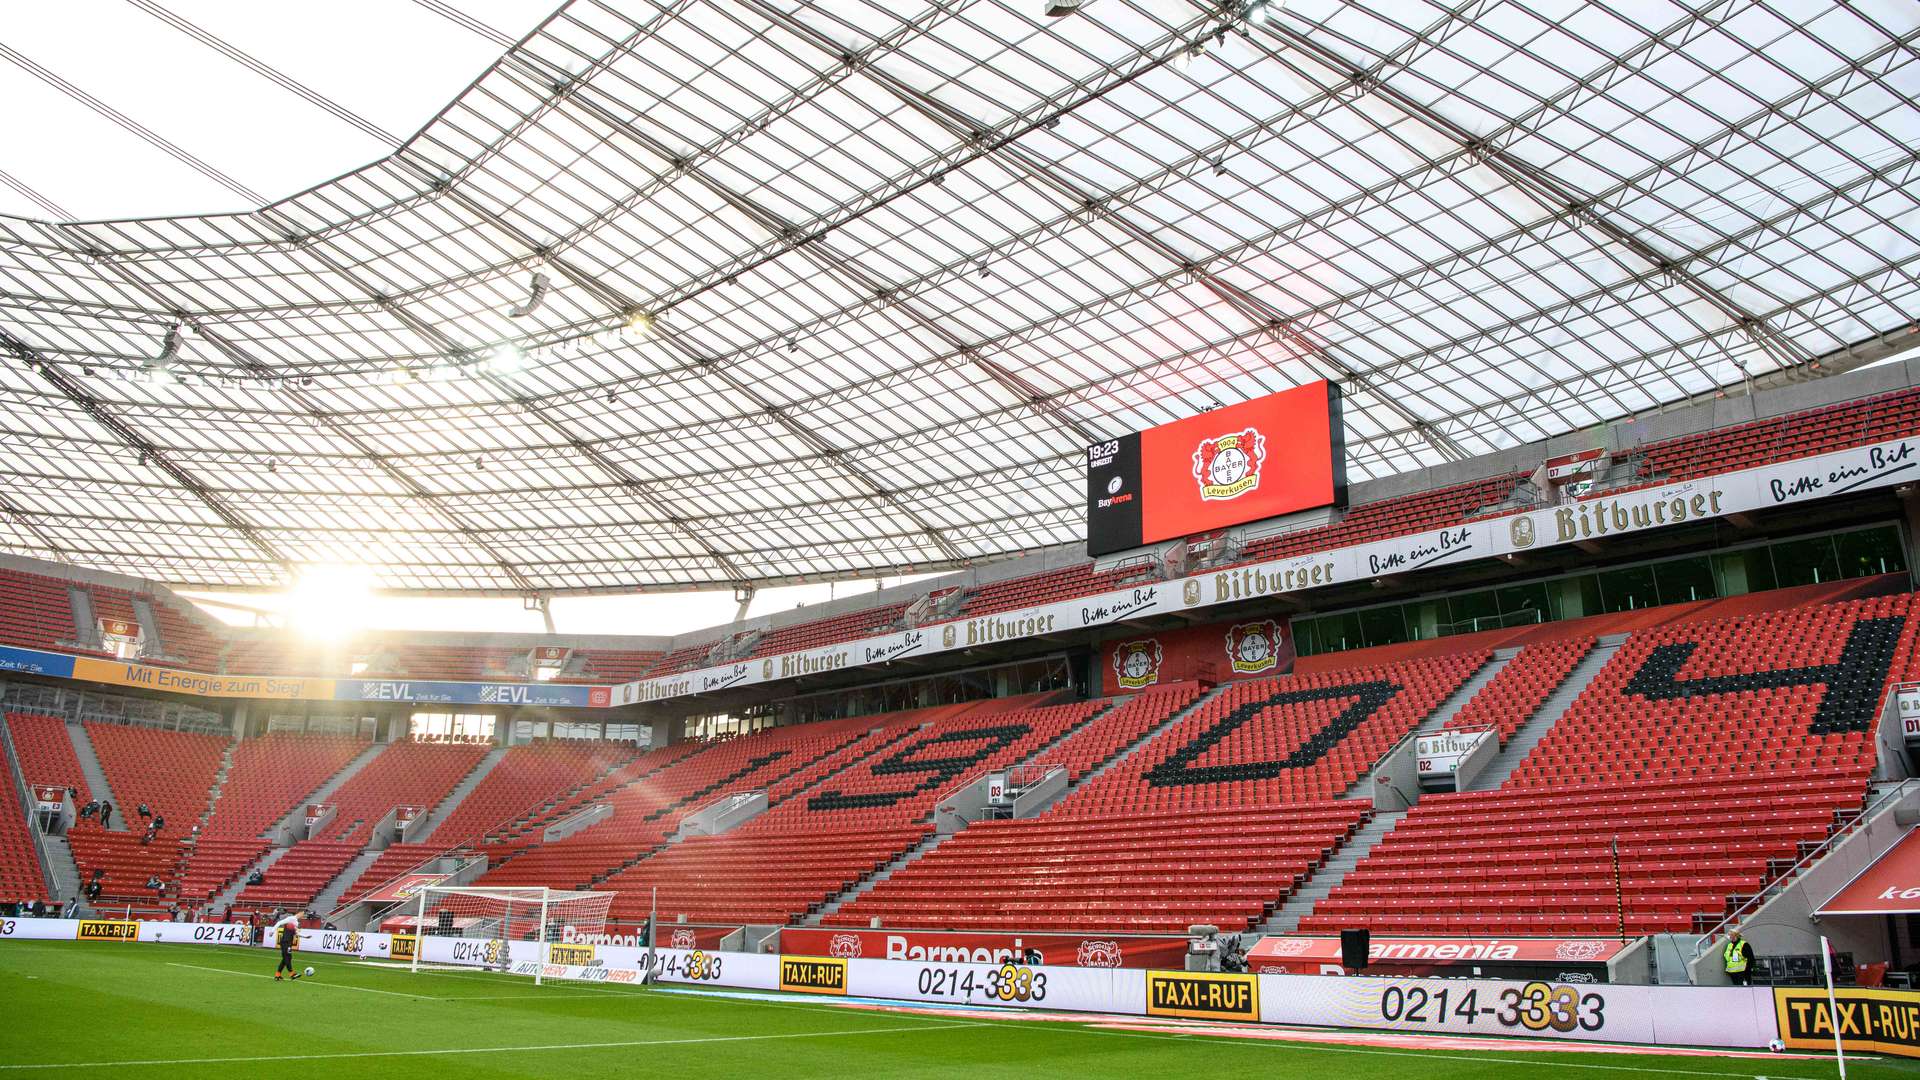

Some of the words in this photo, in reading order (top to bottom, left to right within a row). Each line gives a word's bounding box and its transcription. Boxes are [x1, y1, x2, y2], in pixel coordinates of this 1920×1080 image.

[1089, 440, 1119, 460] 19:23
[1220, 440, 1236, 449] 1904
[1215, 461, 1243, 473] BAYER
[1770, 476, 1823, 503] Bitte
[1828, 466, 1868, 482] ein
[1870, 442, 1915, 469] Bit
[1207, 479, 1253, 495] Leverkusen
[1098, 493, 1132, 508] BayArena
[1555, 489, 1723, 542] Bitburger
[1369, 553, 1406, 574] Bitte
[1410, 546, 1438, 560] ein
[1440, 528, 1472, 549] Bit
[1215, 562, 1334, 602] Bitburger
[1082, 608, 1108, 625] Bitte
[1111, 601, 1133, 614] ein
[1133, 587, 1157, 606] Bit
[967, 613, 1055, 646] Bitburger
[866, 648, 886, 662] Bitte
[888, 643, 903, 653] ein
[905, 632, 922, 647] Bit
[781, 651, 848, 677] Bitburger
[126, 665, 152, 683] Mit
[158, 671, 222, 693] Energie
[226, 681, 260, 693] zum
[265, 679, 305, 697] Sieg!
[703, 677, 719, 690] Bitte
[721, 674, 733, 683] ein
[734, 664, 748, 677] Bit
[379, 682, 413, 700] EVL
[497, 686, 533, 703] EVL
[637, 680, 690, 702] Bitburger
[1419, 760, 1431, 771] D2
[991, 786, 1001, 797] D3
[83, 924, 135, 937] TAXI-RUF
[393, 940, 417, 957] TAXI-RU
[1333, 940, 1518, 960] armenia
[579, 967, 638, 982] AUTOHERO
[784, 964, 842, 986] TAXI-RUF
[918, 964, 1047, 1002] 0214-3333
[1154, 980, 1249, 1009] TAXI-RUF
[1381, 981, 1605, 1032] 0214-3333
[1791, 1002, 1920, 1040] TAXI-RUF
